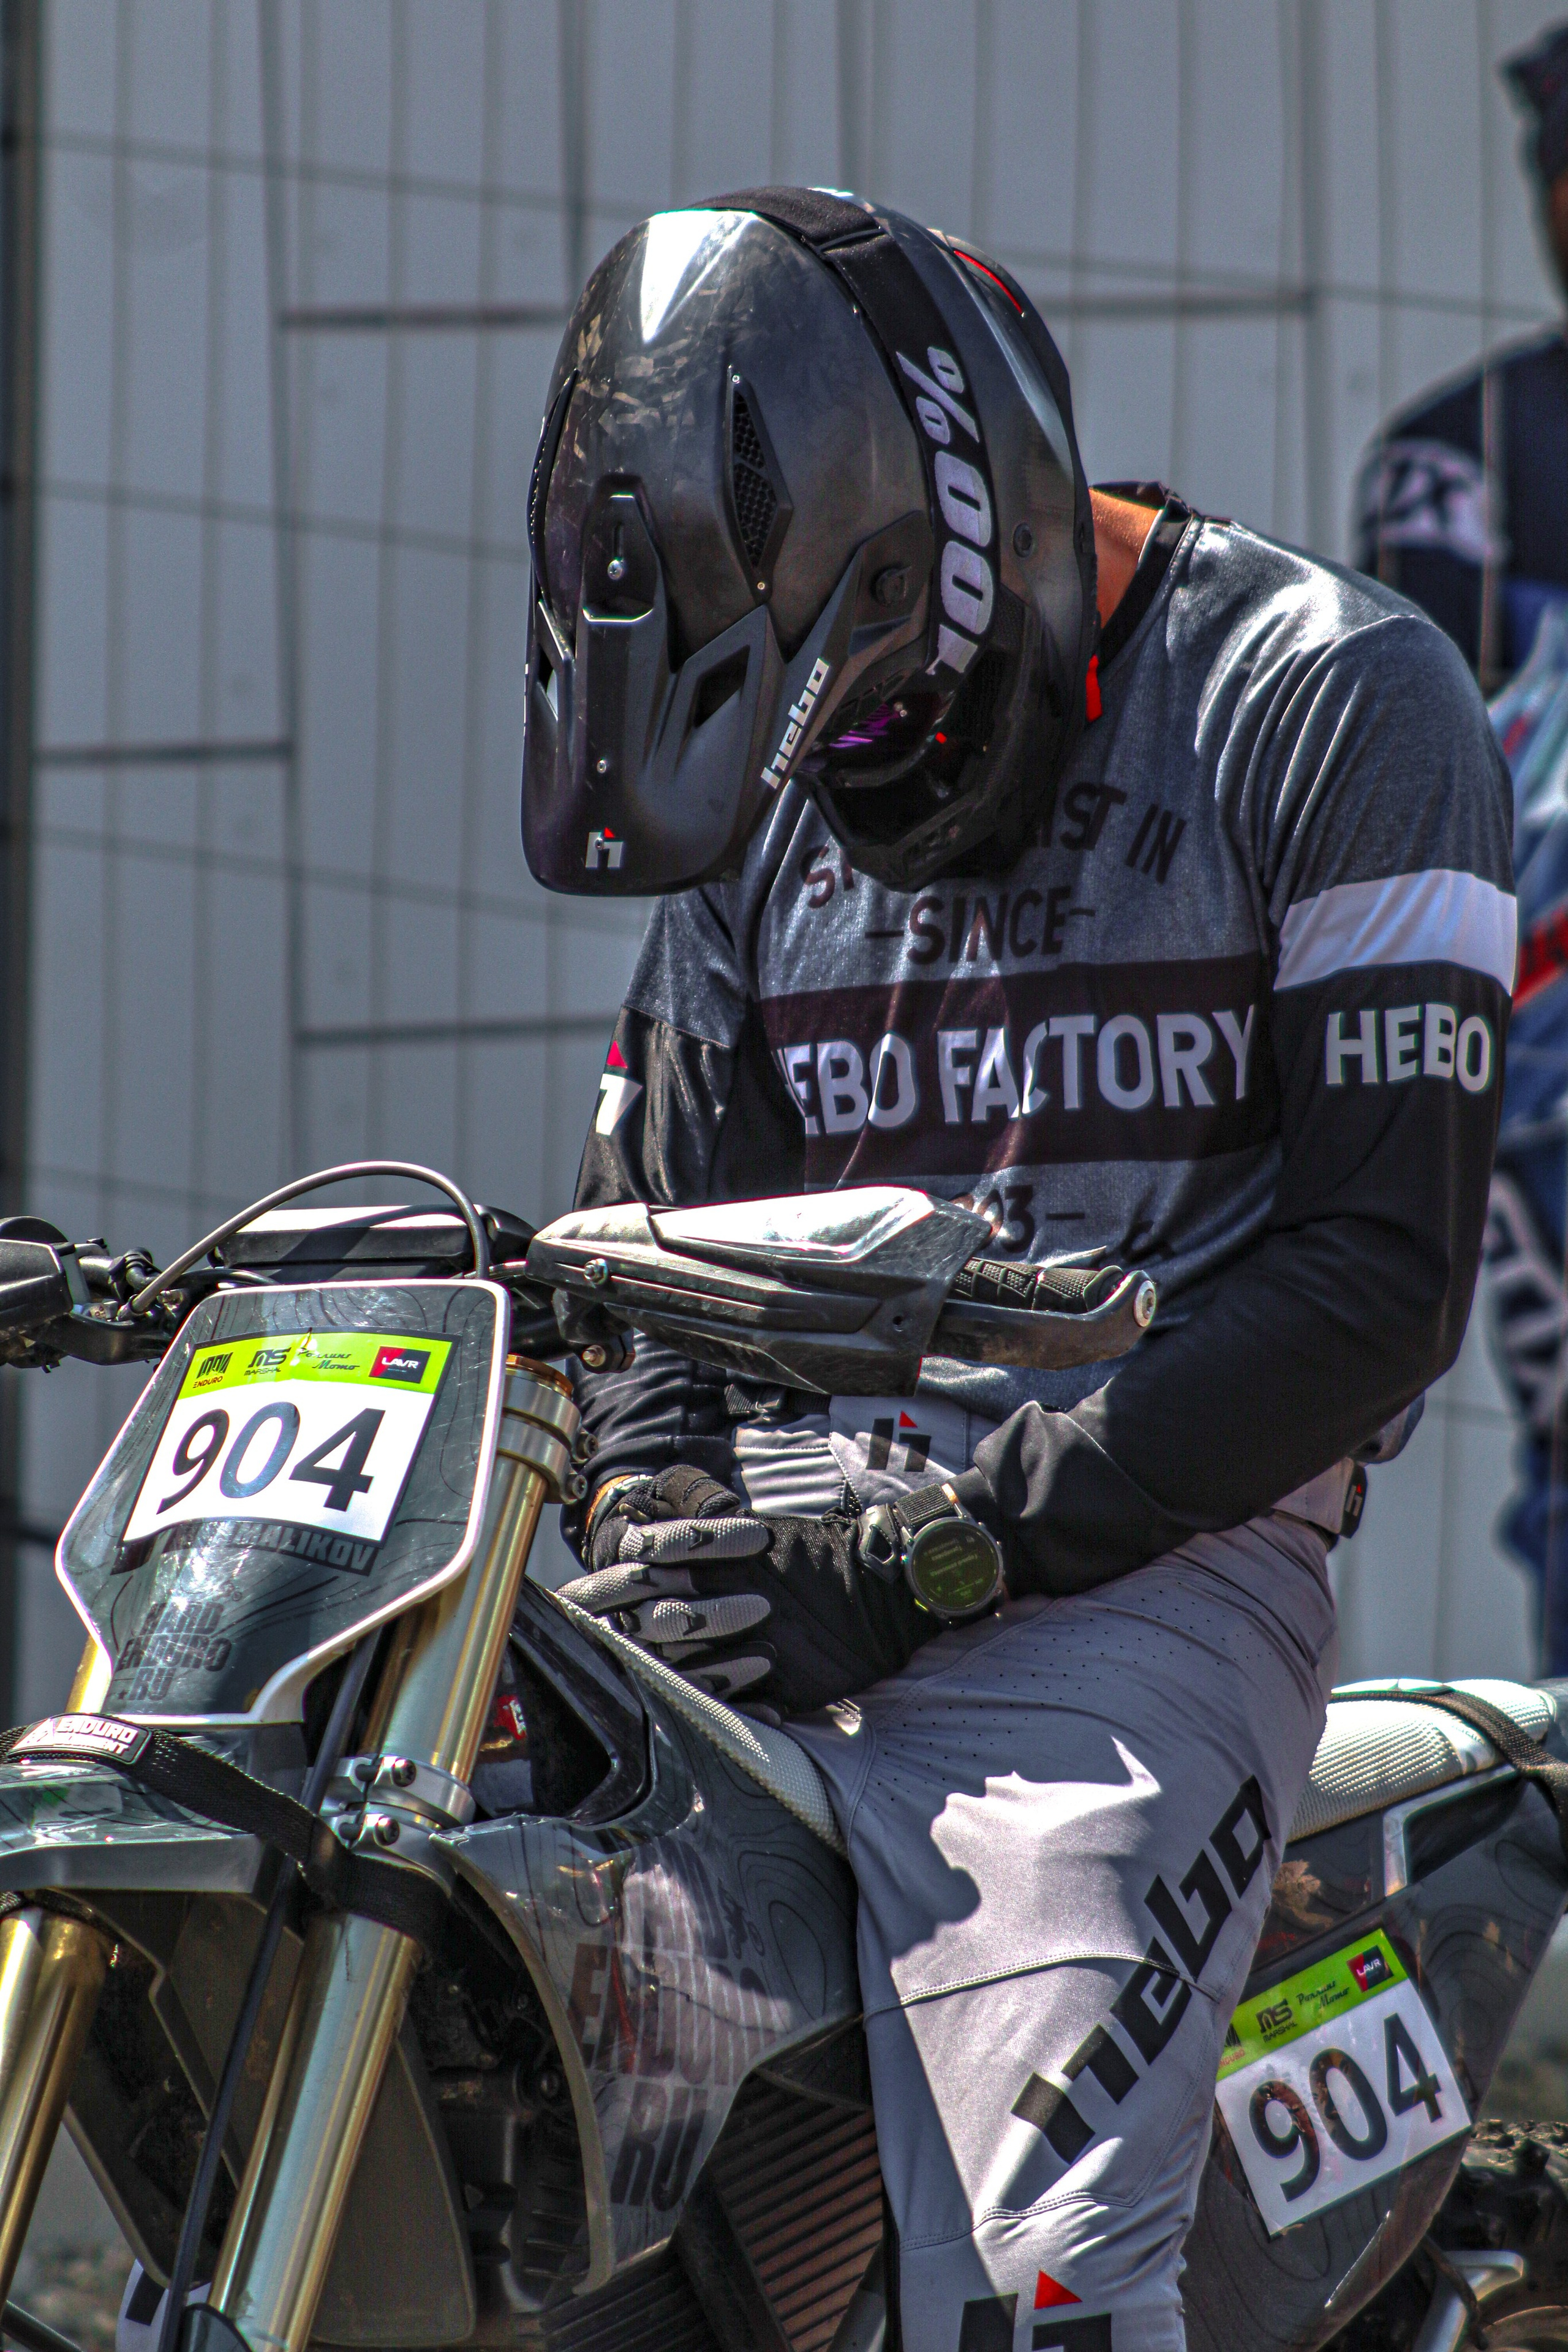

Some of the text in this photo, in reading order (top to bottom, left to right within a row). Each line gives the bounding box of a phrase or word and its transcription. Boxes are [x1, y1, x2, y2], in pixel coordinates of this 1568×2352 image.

[896, 346, 994, 676] 100%
[760, 657, 830, 790] hebo
[771, 1003, 1254, 1135] EBO FACTORY
[1325, 1003, 1491, 1093] HEBO
[192, 1376, 224, 1389] ENDURO
[381, 1357, 419, 1369] LAVR
[156, 1401, 387, 1515] 904
[56, 1716, 138, 1744] ENDURO
[1011, 1773, 1272, 2166] hebo
[1356, 1958, 1382, 1977] LAVR
[1248, 2012, 1442, 2203] 904
